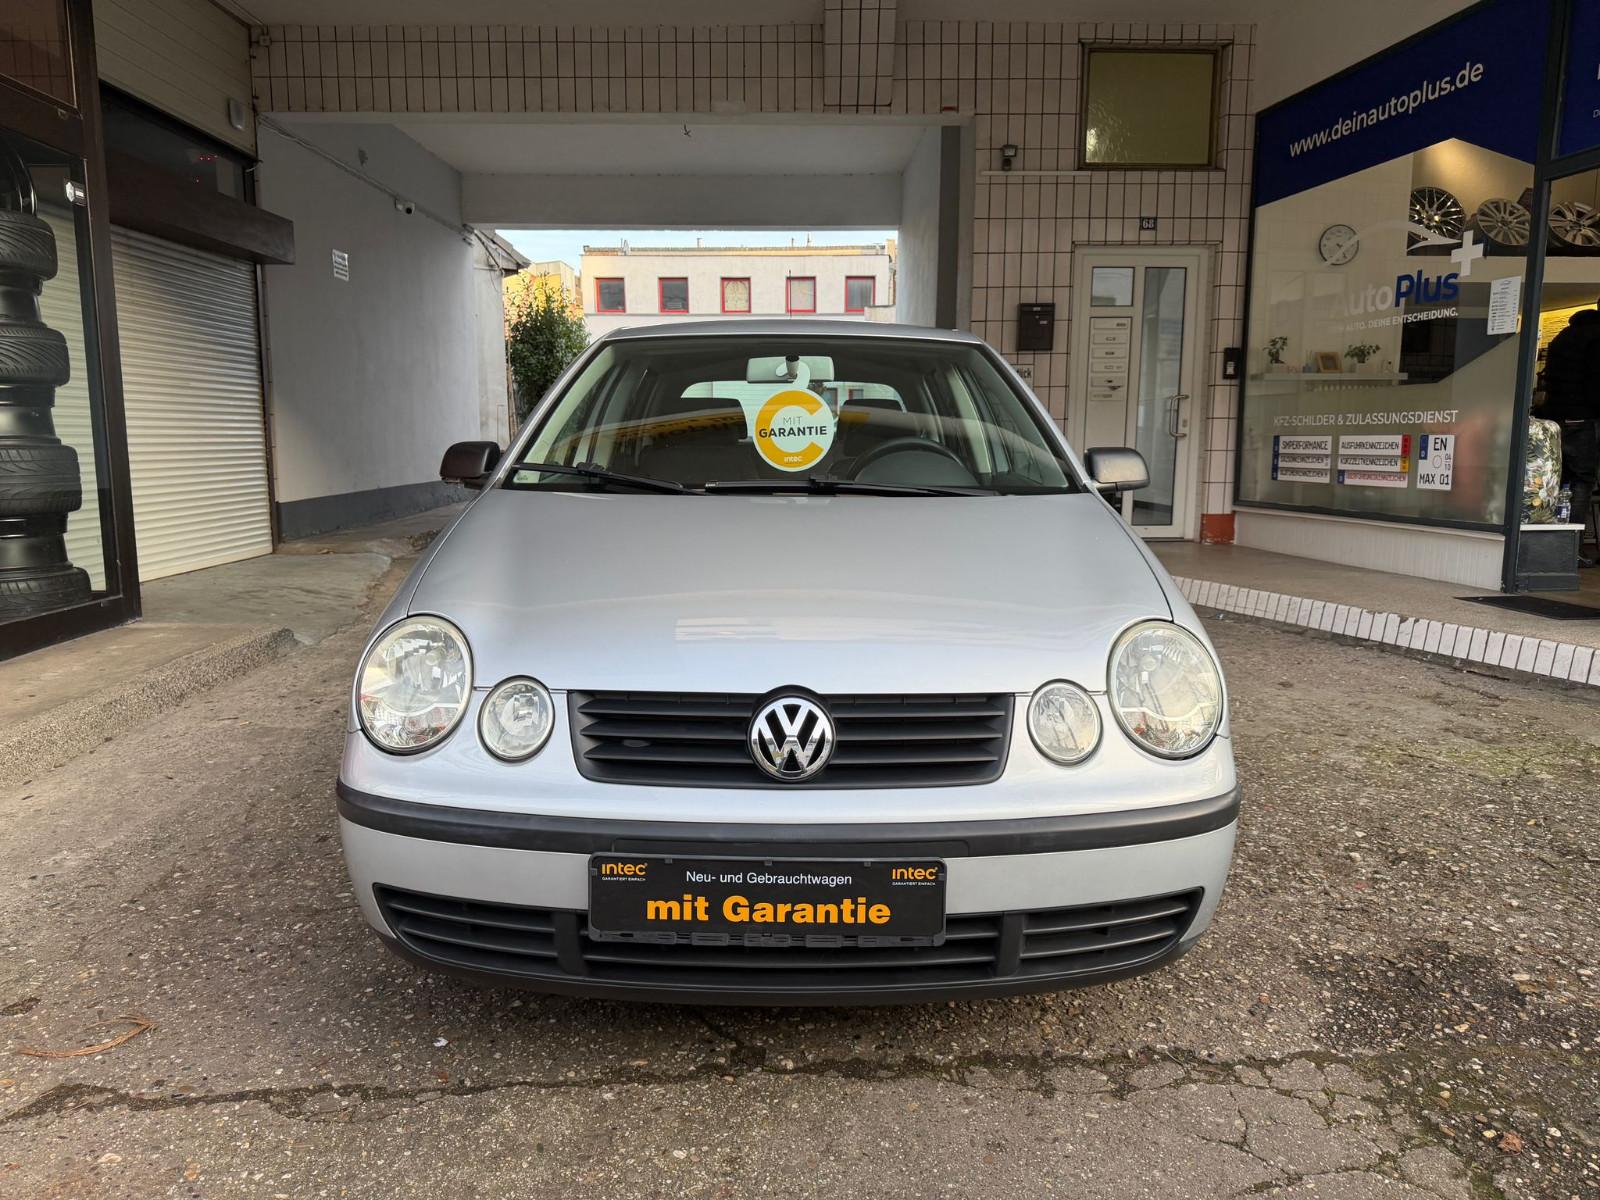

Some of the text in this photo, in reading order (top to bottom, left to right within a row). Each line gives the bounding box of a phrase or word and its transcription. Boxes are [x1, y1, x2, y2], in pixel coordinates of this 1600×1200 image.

[1289, 61, 1484, 158] www.deinautoplus.de
[1143, 218, 1155, 229] 68
[1392, 307, 1460, 325] ENTSCHEIDUNG.
[783, 415, 803, 425] MIT
[1337, 414, 1344, 425] &
[1345, 410, 1459, 425] ZULASSUNGSDIENST
[759, 426, 828, 438] GARANTIE
[1433, 437, 1448, 451] EN
[1419, 473, 1436, 485] MAX
[1439, 474, 1450, 485] 01
[601, 862, 646, 876] intec
[892, 866, 937, 880] intec
[686, 871, 853, 887] Neu- und Gebrauchtwagen
[646, 894, 892, 925] mit Garantie
